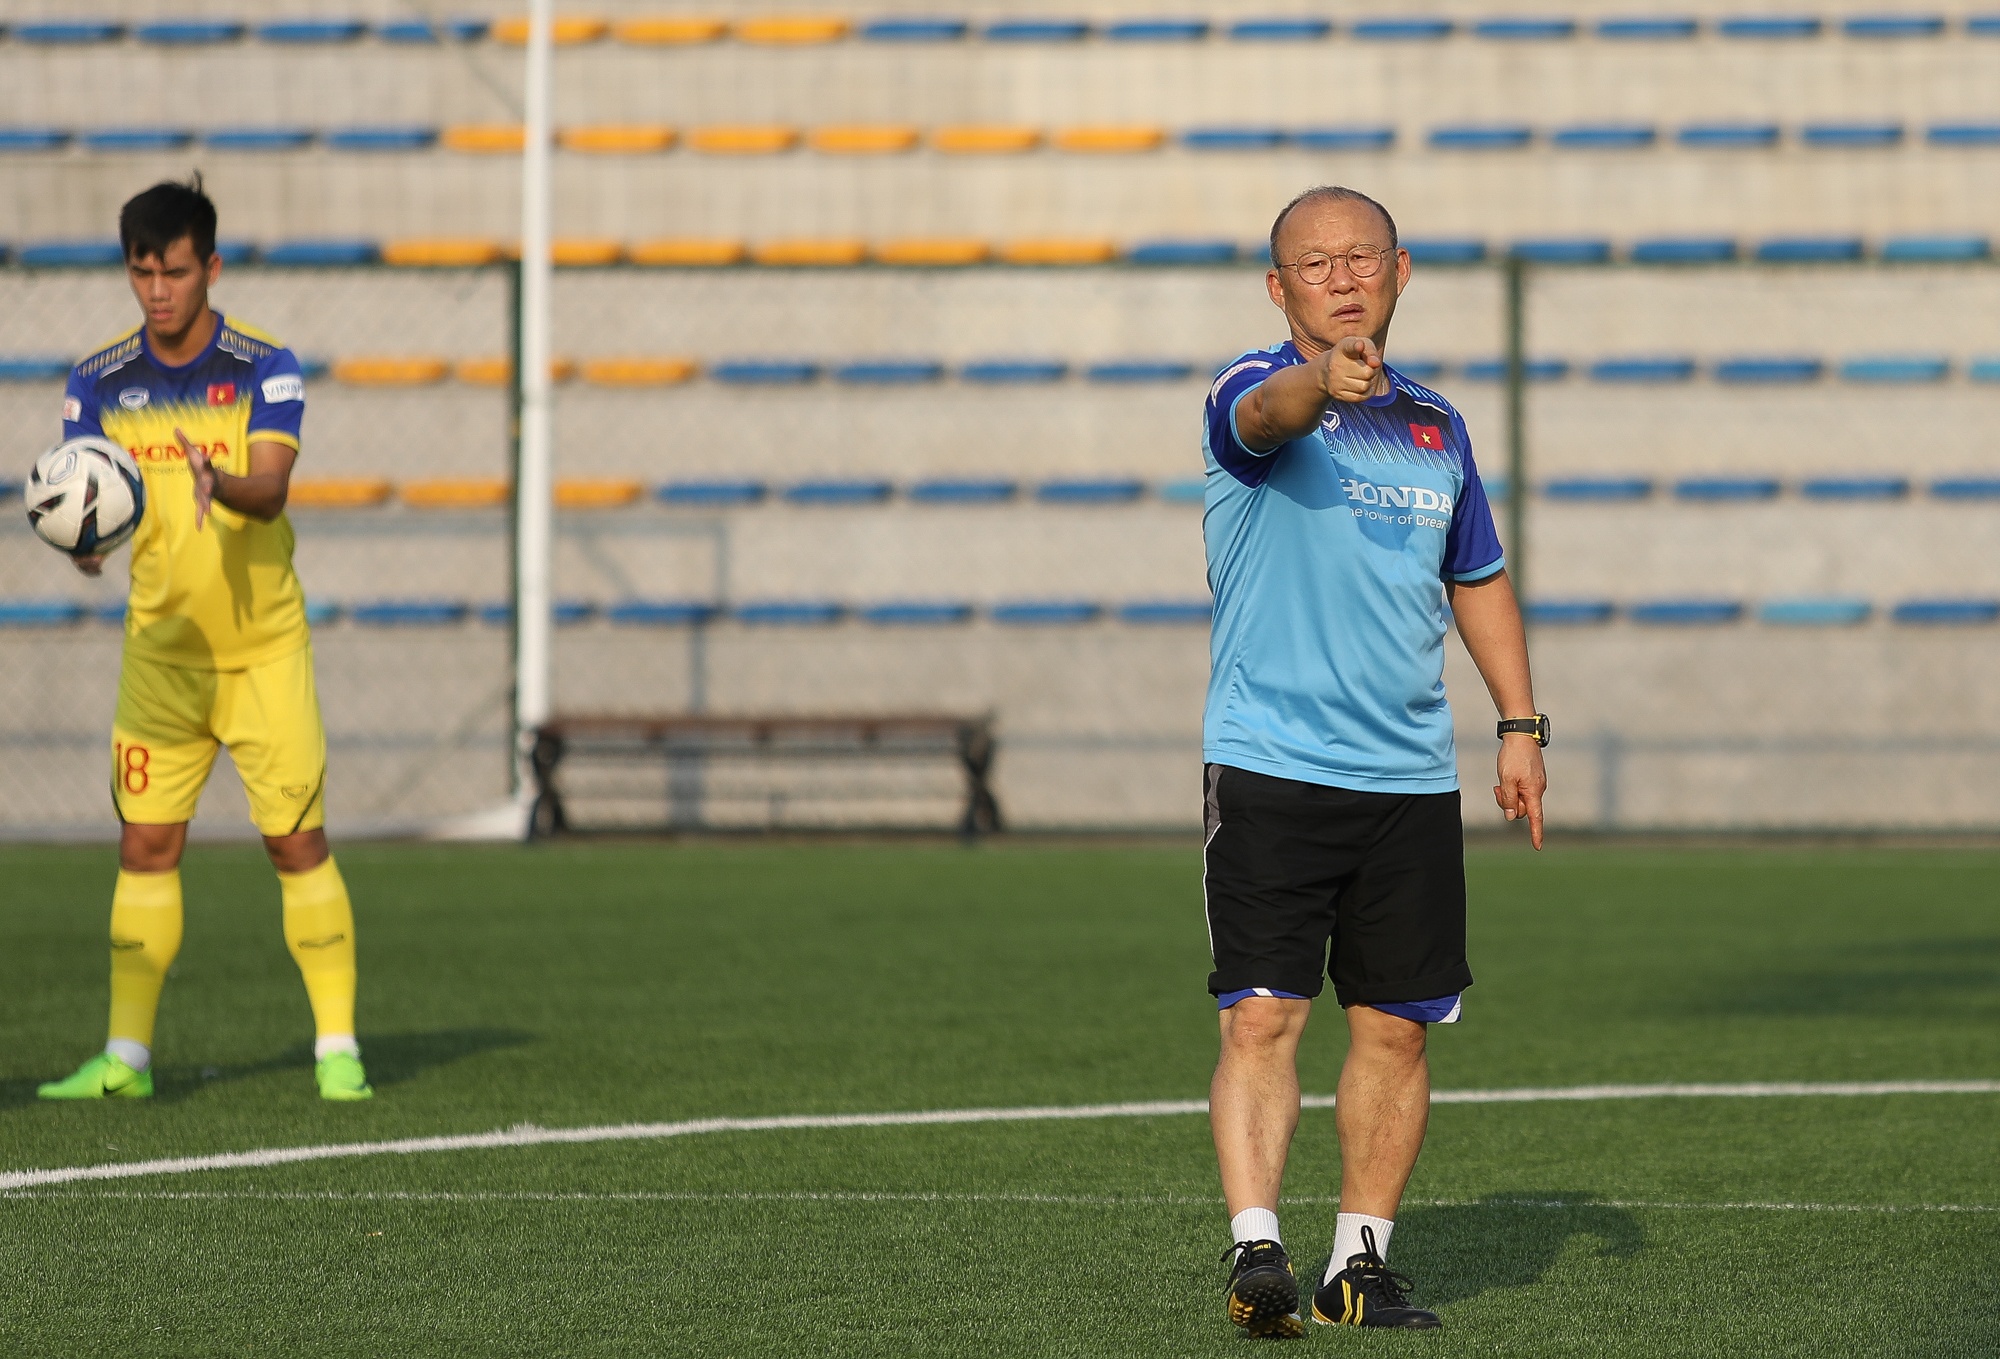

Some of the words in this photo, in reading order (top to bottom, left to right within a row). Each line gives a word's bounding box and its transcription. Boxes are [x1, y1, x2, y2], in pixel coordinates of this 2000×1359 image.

[1339, 478, 1453, 517] HONDA
[1397, 512, 1413, 525] of
[115, 741, 150, 795] 18
[1251, 1242, 1272, 1253] mmel
